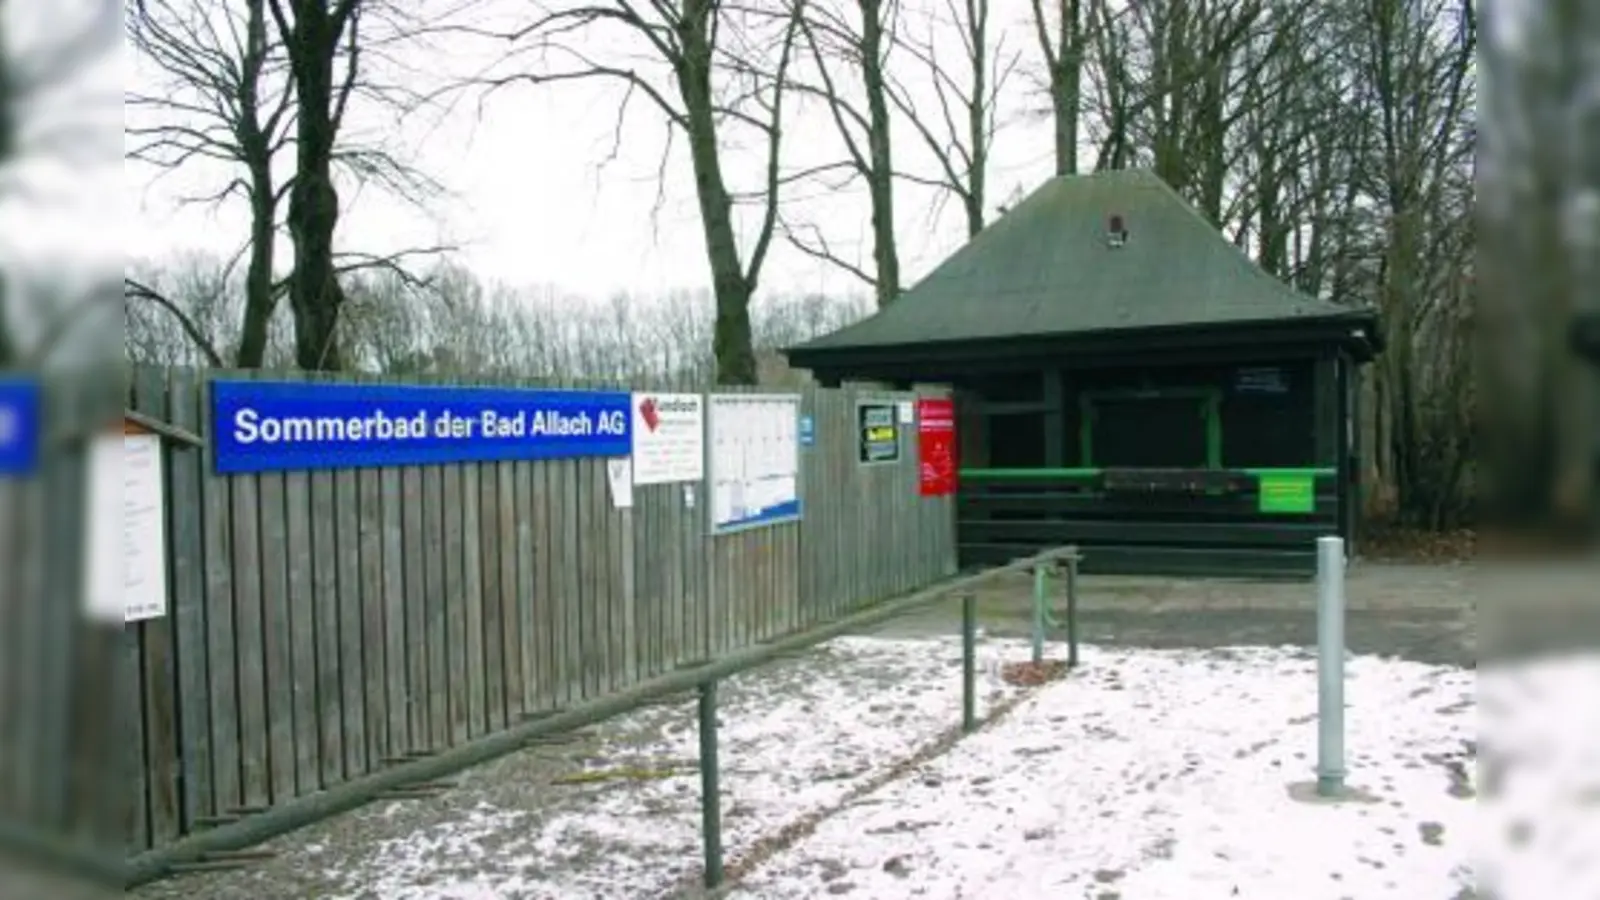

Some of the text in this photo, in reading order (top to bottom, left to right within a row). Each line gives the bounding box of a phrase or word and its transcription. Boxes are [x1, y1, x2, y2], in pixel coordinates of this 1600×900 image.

[234, 407, 626, 443] Sommerbad der Bad Allach AG
